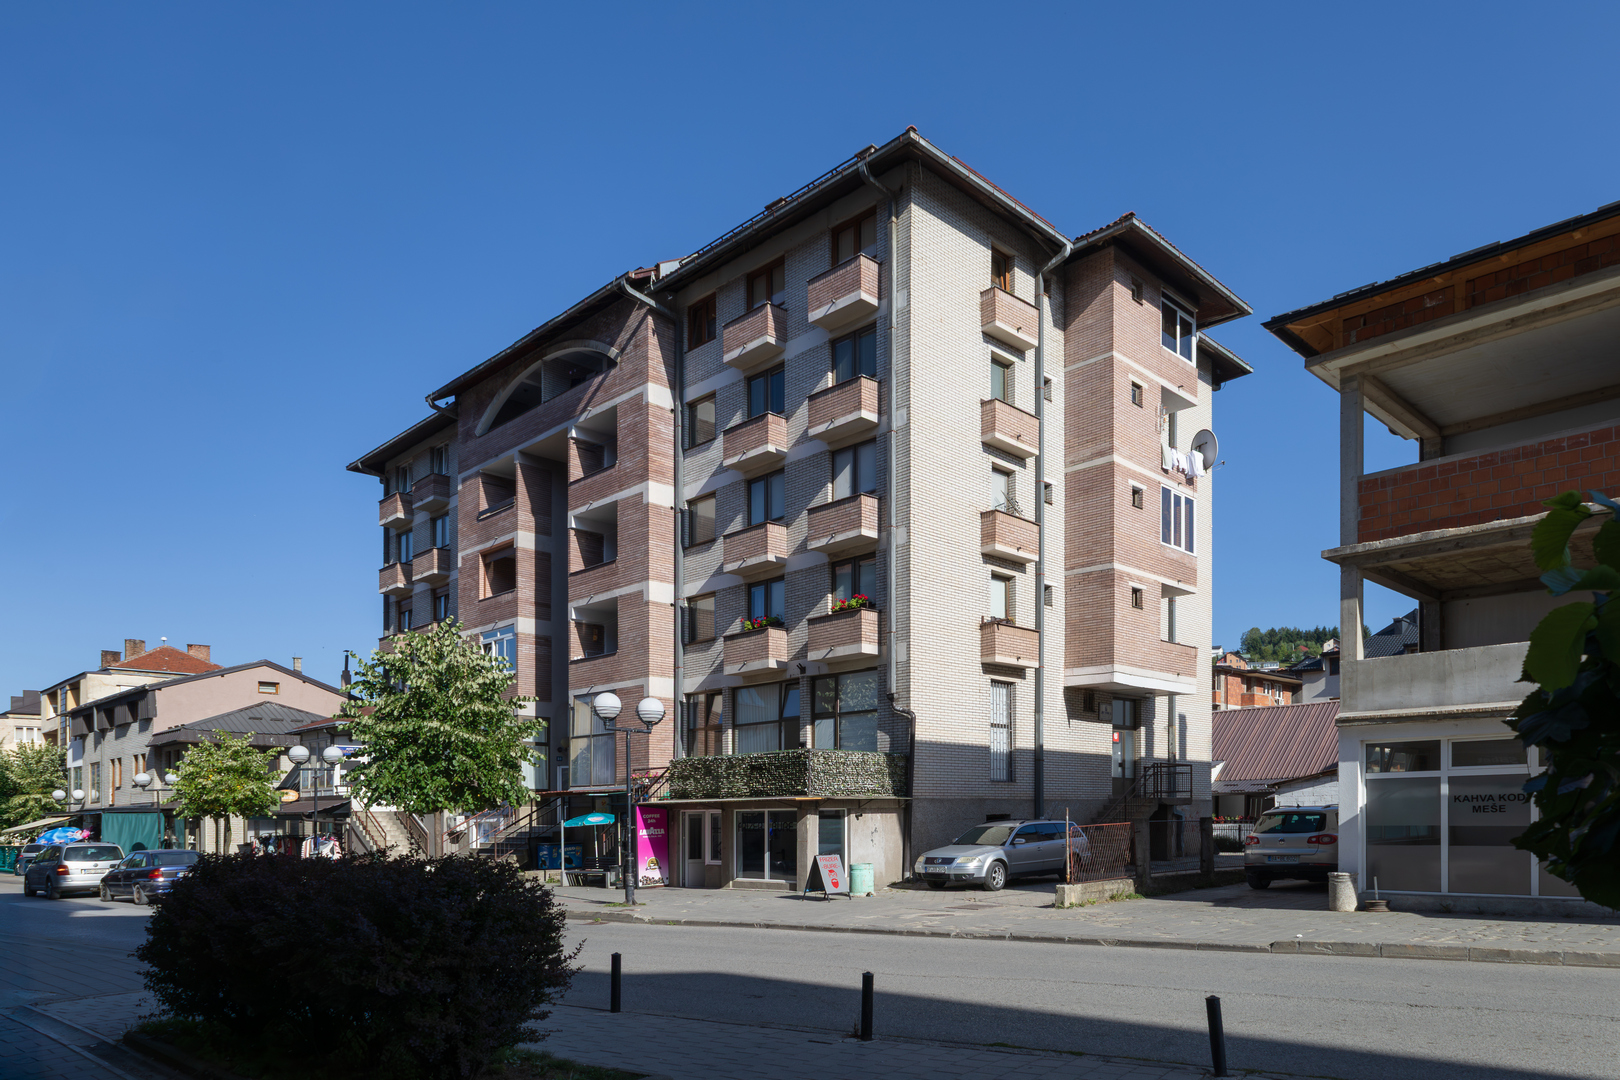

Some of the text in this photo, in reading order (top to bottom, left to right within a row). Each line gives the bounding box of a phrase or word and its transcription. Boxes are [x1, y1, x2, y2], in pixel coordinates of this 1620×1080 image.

[1454, 793, 1526, 803] KAHVA KOD
[1472, 803, 1506, 813] MEŠE
